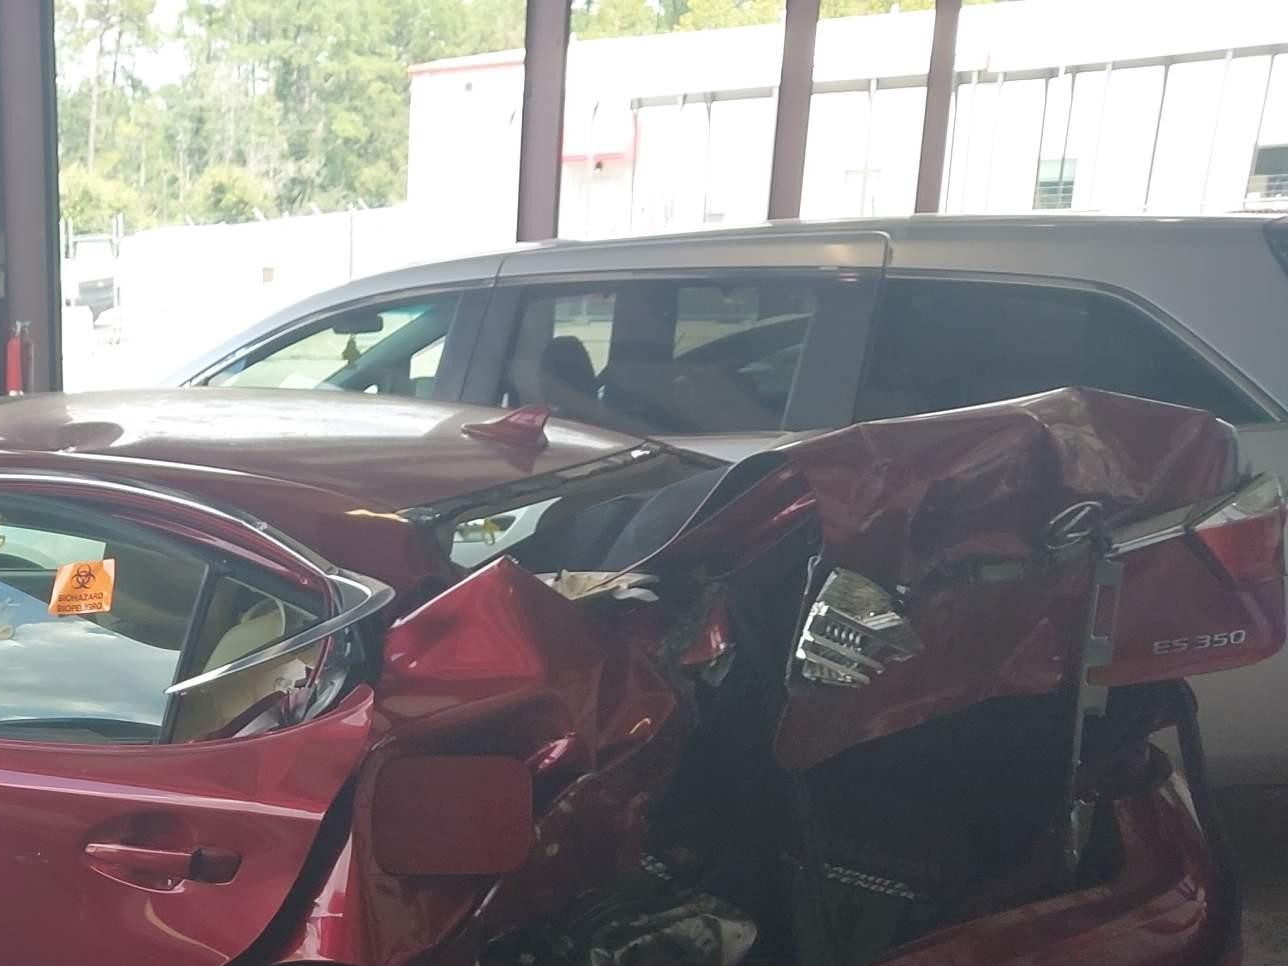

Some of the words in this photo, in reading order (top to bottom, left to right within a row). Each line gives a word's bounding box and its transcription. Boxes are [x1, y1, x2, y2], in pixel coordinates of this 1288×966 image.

[57, 592, 104, 602] BIOHAZARD
[1153, 638, 1189, 655] ES
[1193, 630, 1246, 650] 350
